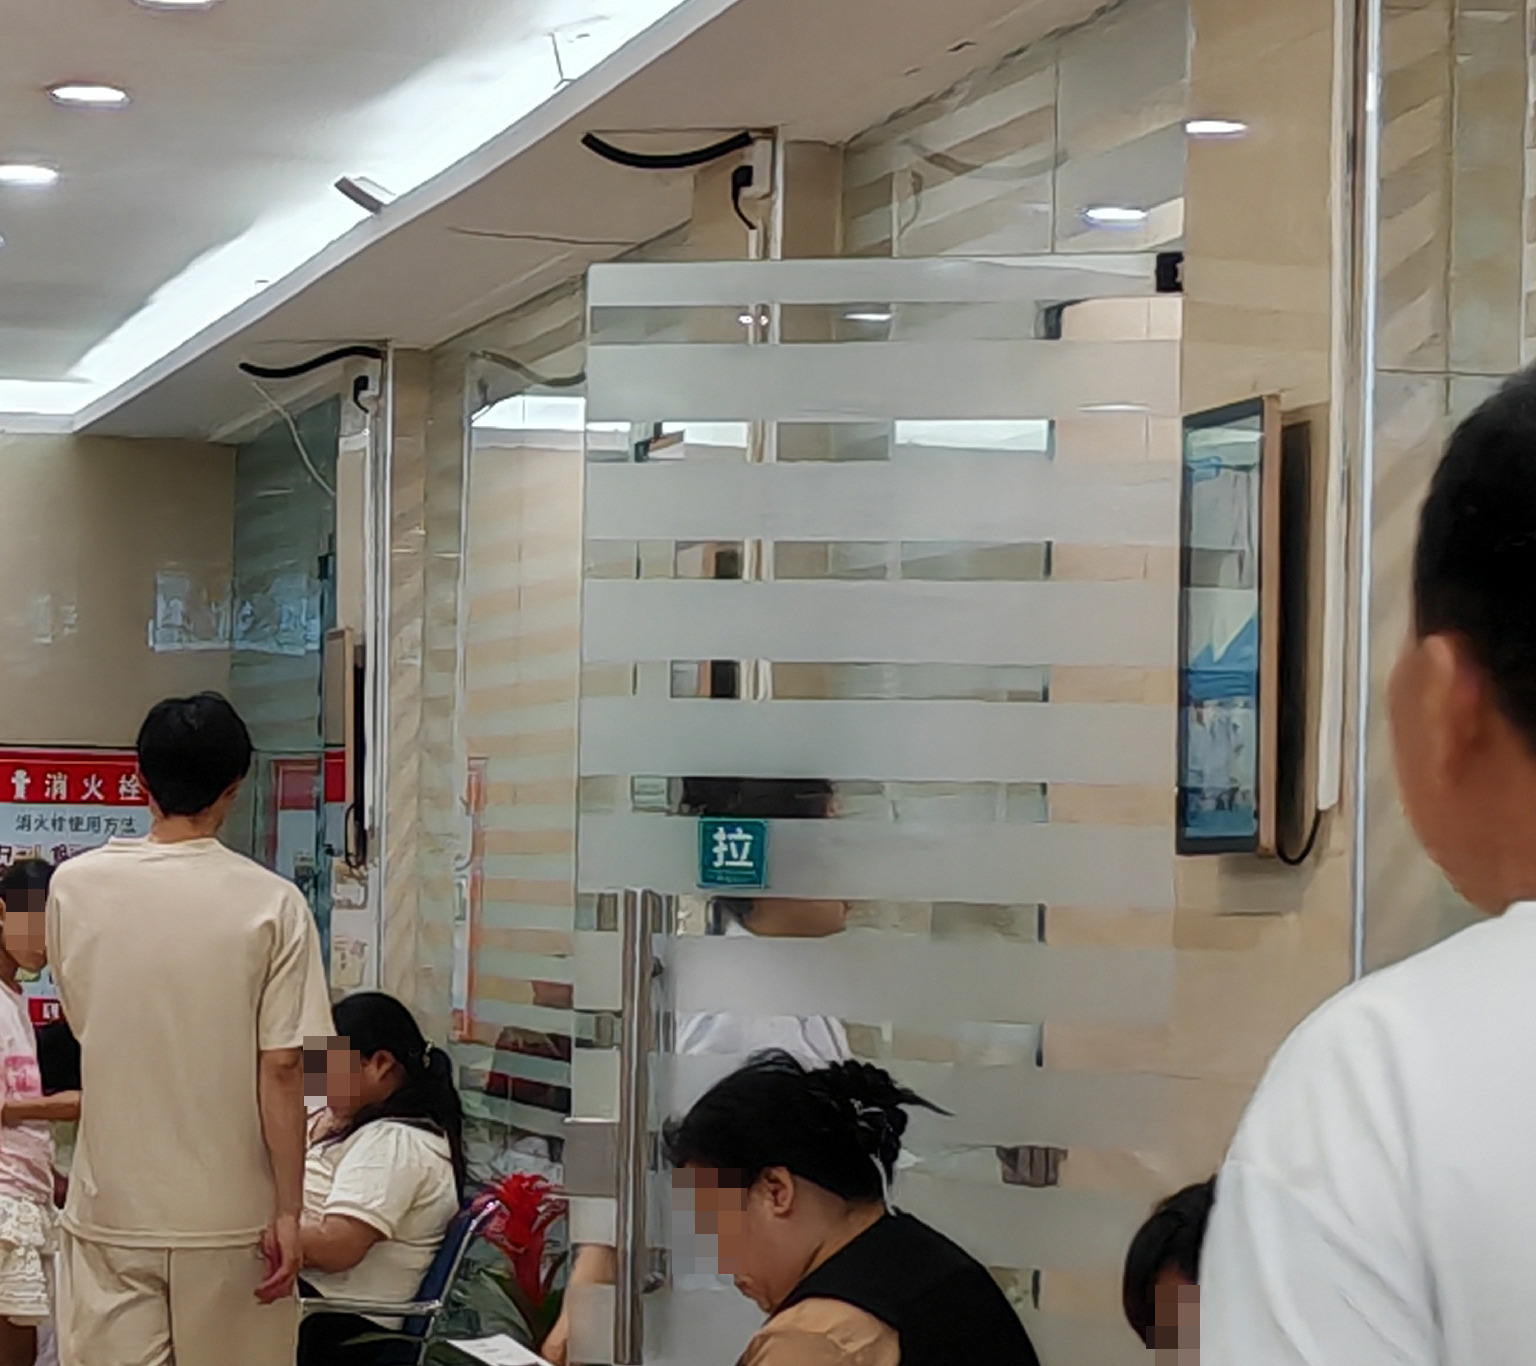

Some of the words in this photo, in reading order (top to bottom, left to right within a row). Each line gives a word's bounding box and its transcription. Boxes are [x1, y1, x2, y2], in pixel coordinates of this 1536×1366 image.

[44, 772, 143, 801] 消火栓
[15, 812, 138, 835] 消火栓使用方法
[711, 826, 754, 868] 拉
